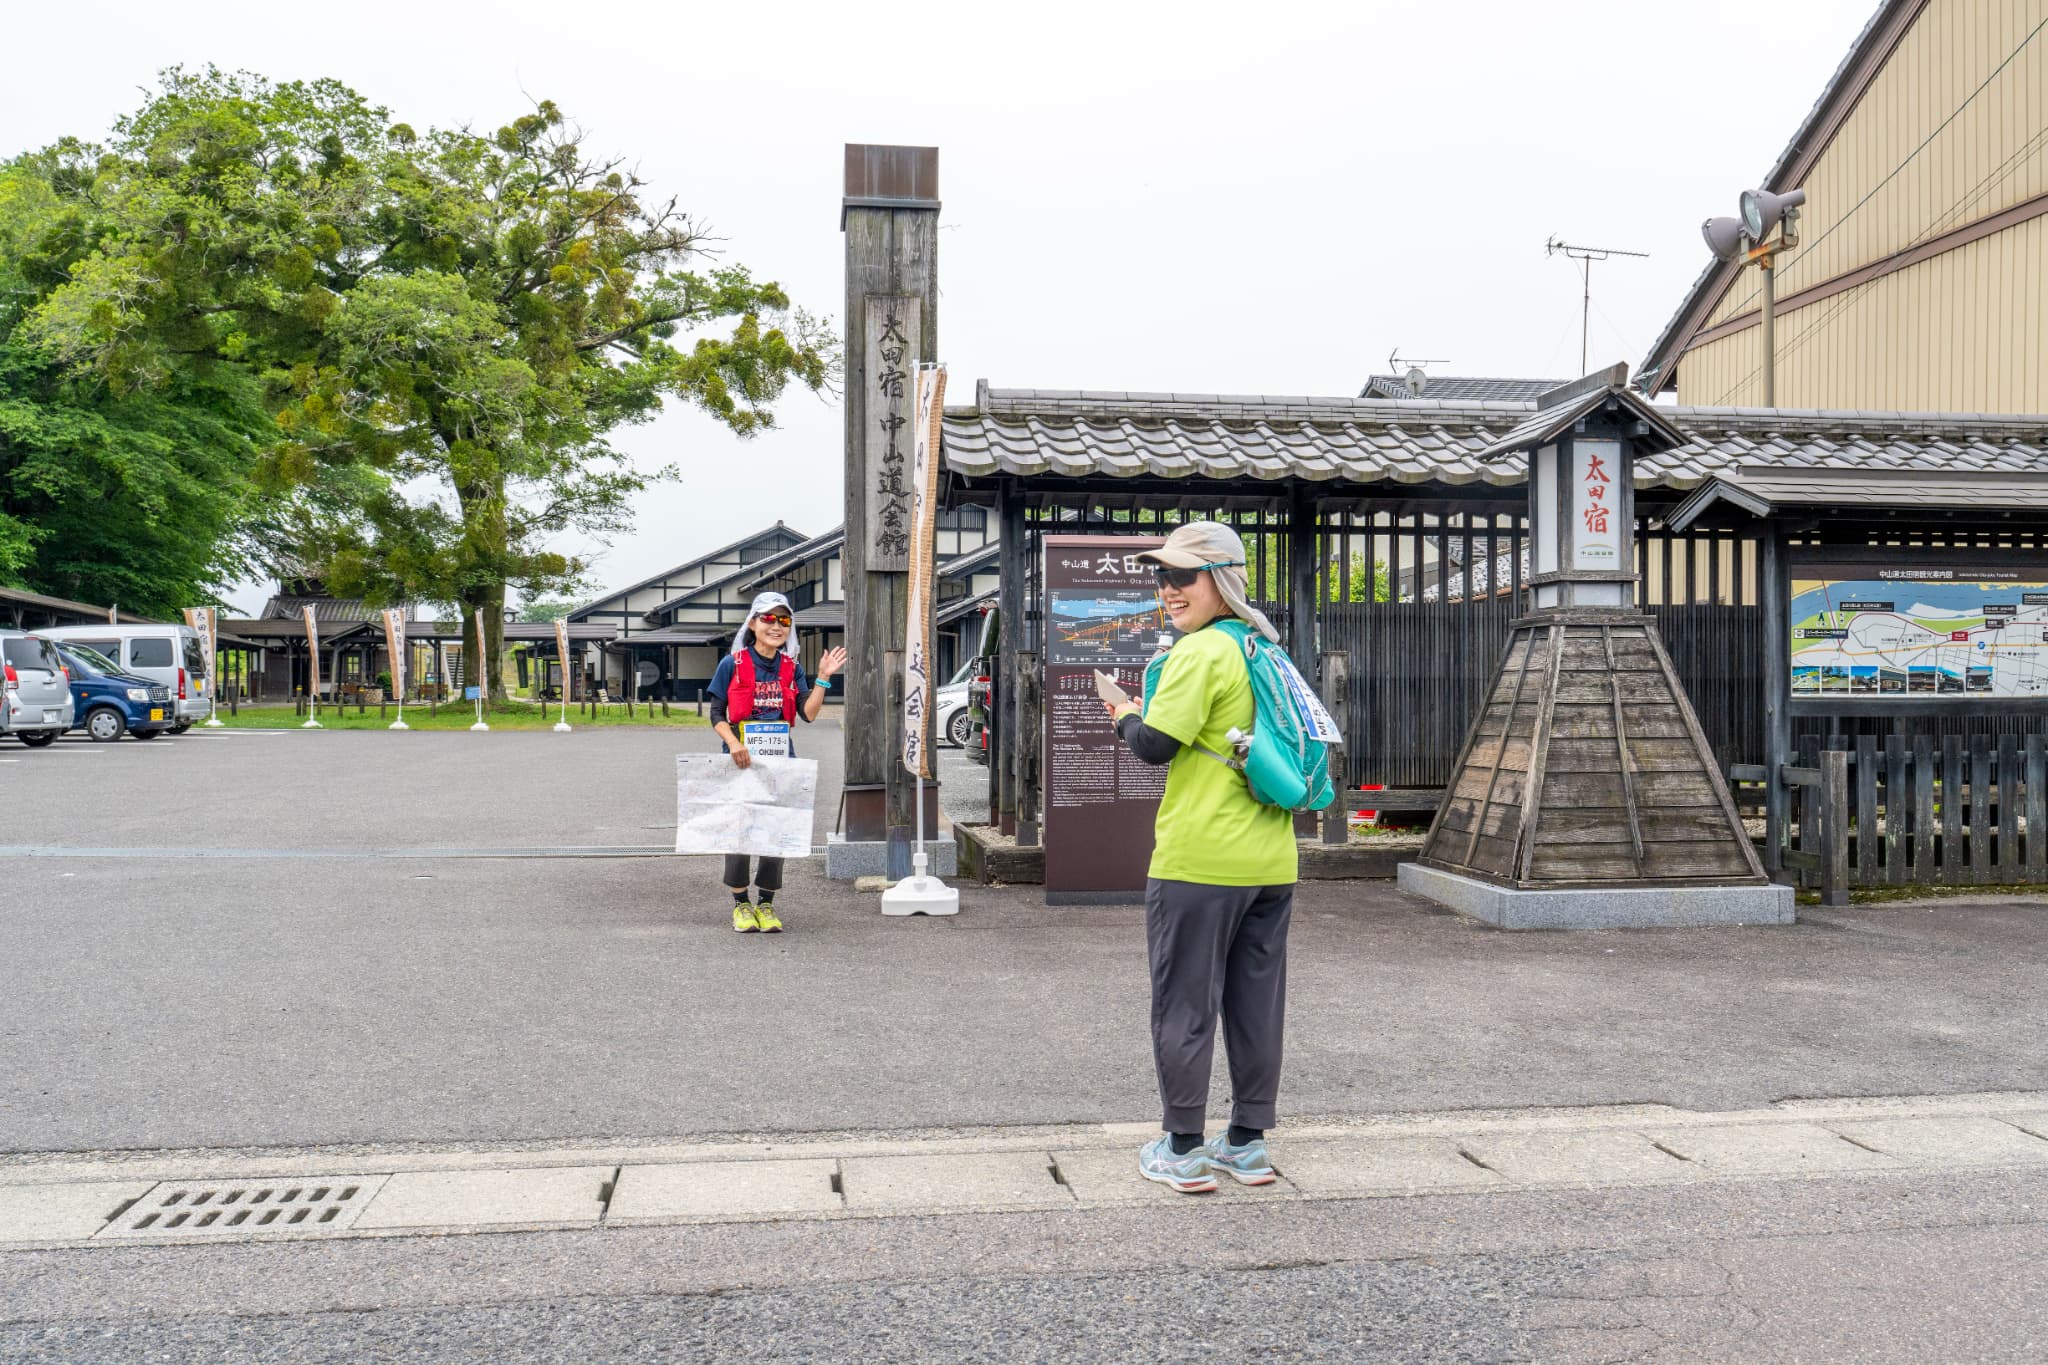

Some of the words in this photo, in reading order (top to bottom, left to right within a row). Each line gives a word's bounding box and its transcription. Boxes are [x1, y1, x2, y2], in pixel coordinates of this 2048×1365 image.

[1584, 454, 1611, 534] 太田宿
[1062, 559, 1089, 569] 中山道
[1095, 552, 1160, 577] 太田
